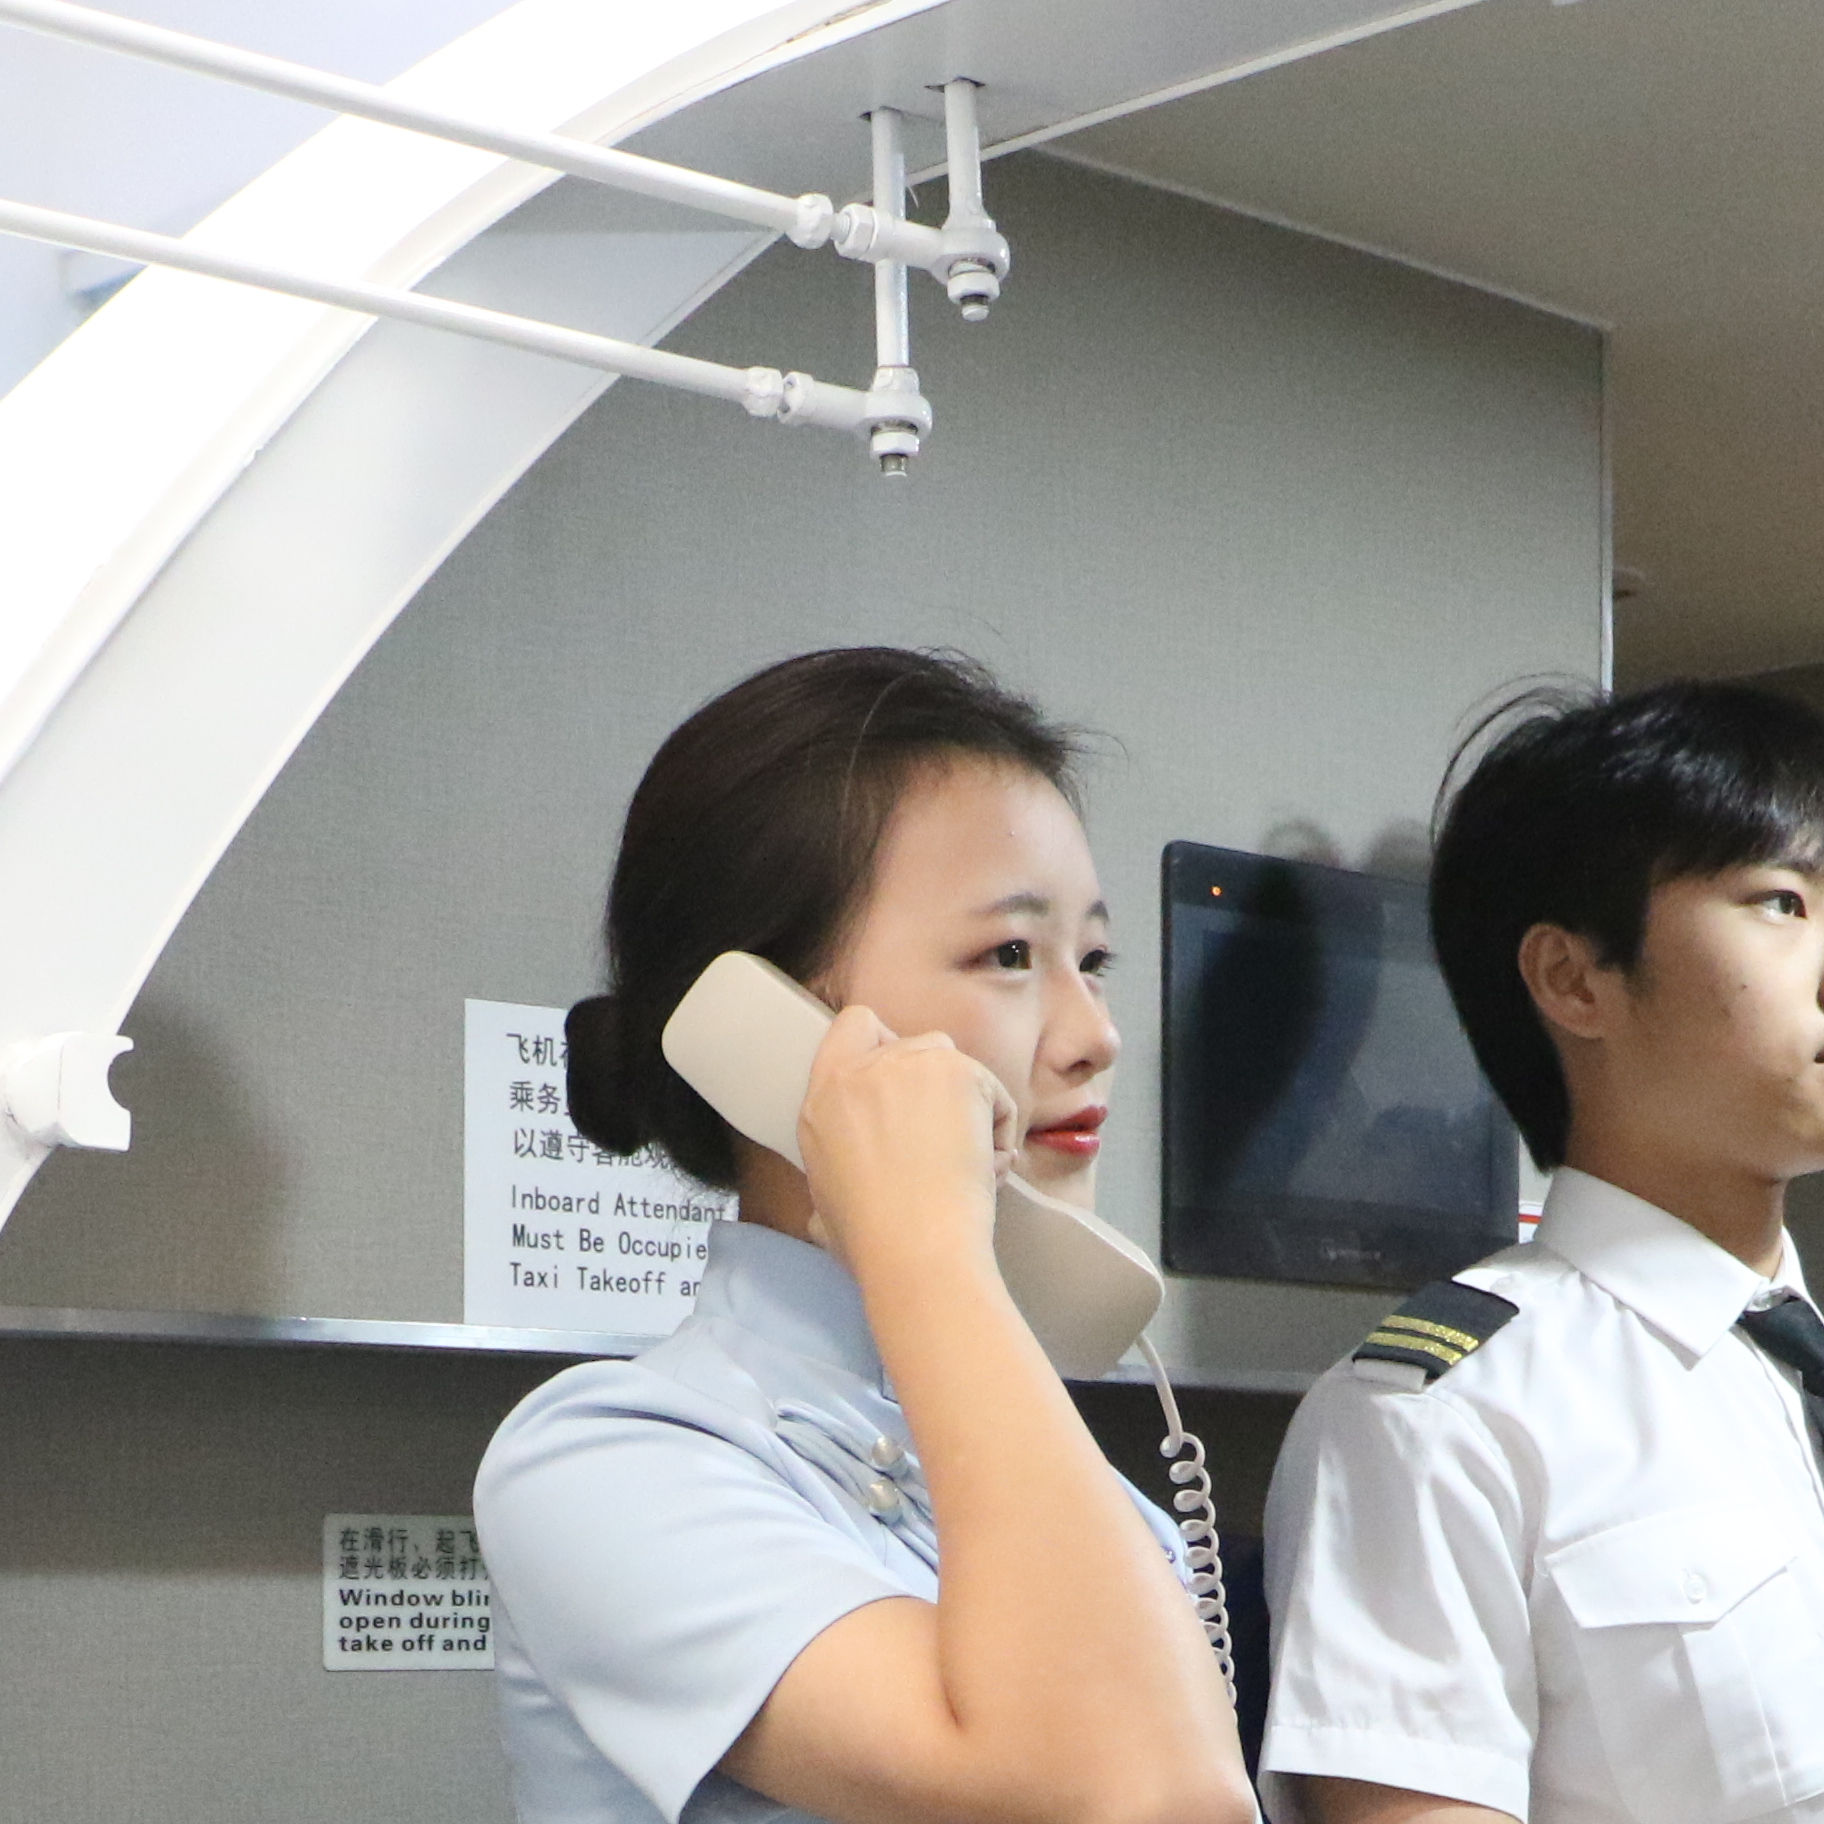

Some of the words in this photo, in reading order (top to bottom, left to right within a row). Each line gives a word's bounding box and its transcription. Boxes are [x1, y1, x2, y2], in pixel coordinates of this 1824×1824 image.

[509, 1081, 570, 1117] 乘务
[511, 1184, 600, 1215] Inboard
[614, 1192, 726, 1222] Attendant
[512, 1223, 565, 1251] Must
[579, 1228, 604, 1253] Be
[510, 1262, 558, 1289] Taxi
[577, 1266, 666, 1295] Takeoff
[339, 1555, 489, 1580] 遮光板必须打
[339, 1589, 444, 1607] Window
[339, 1615, 401, 1633] open
[410, 1612, 490, 1633] during
[338, 1635, 393, 1652] take
[402, 1634, 436, 1652] off
[442, 1634, 487, 1652] and
